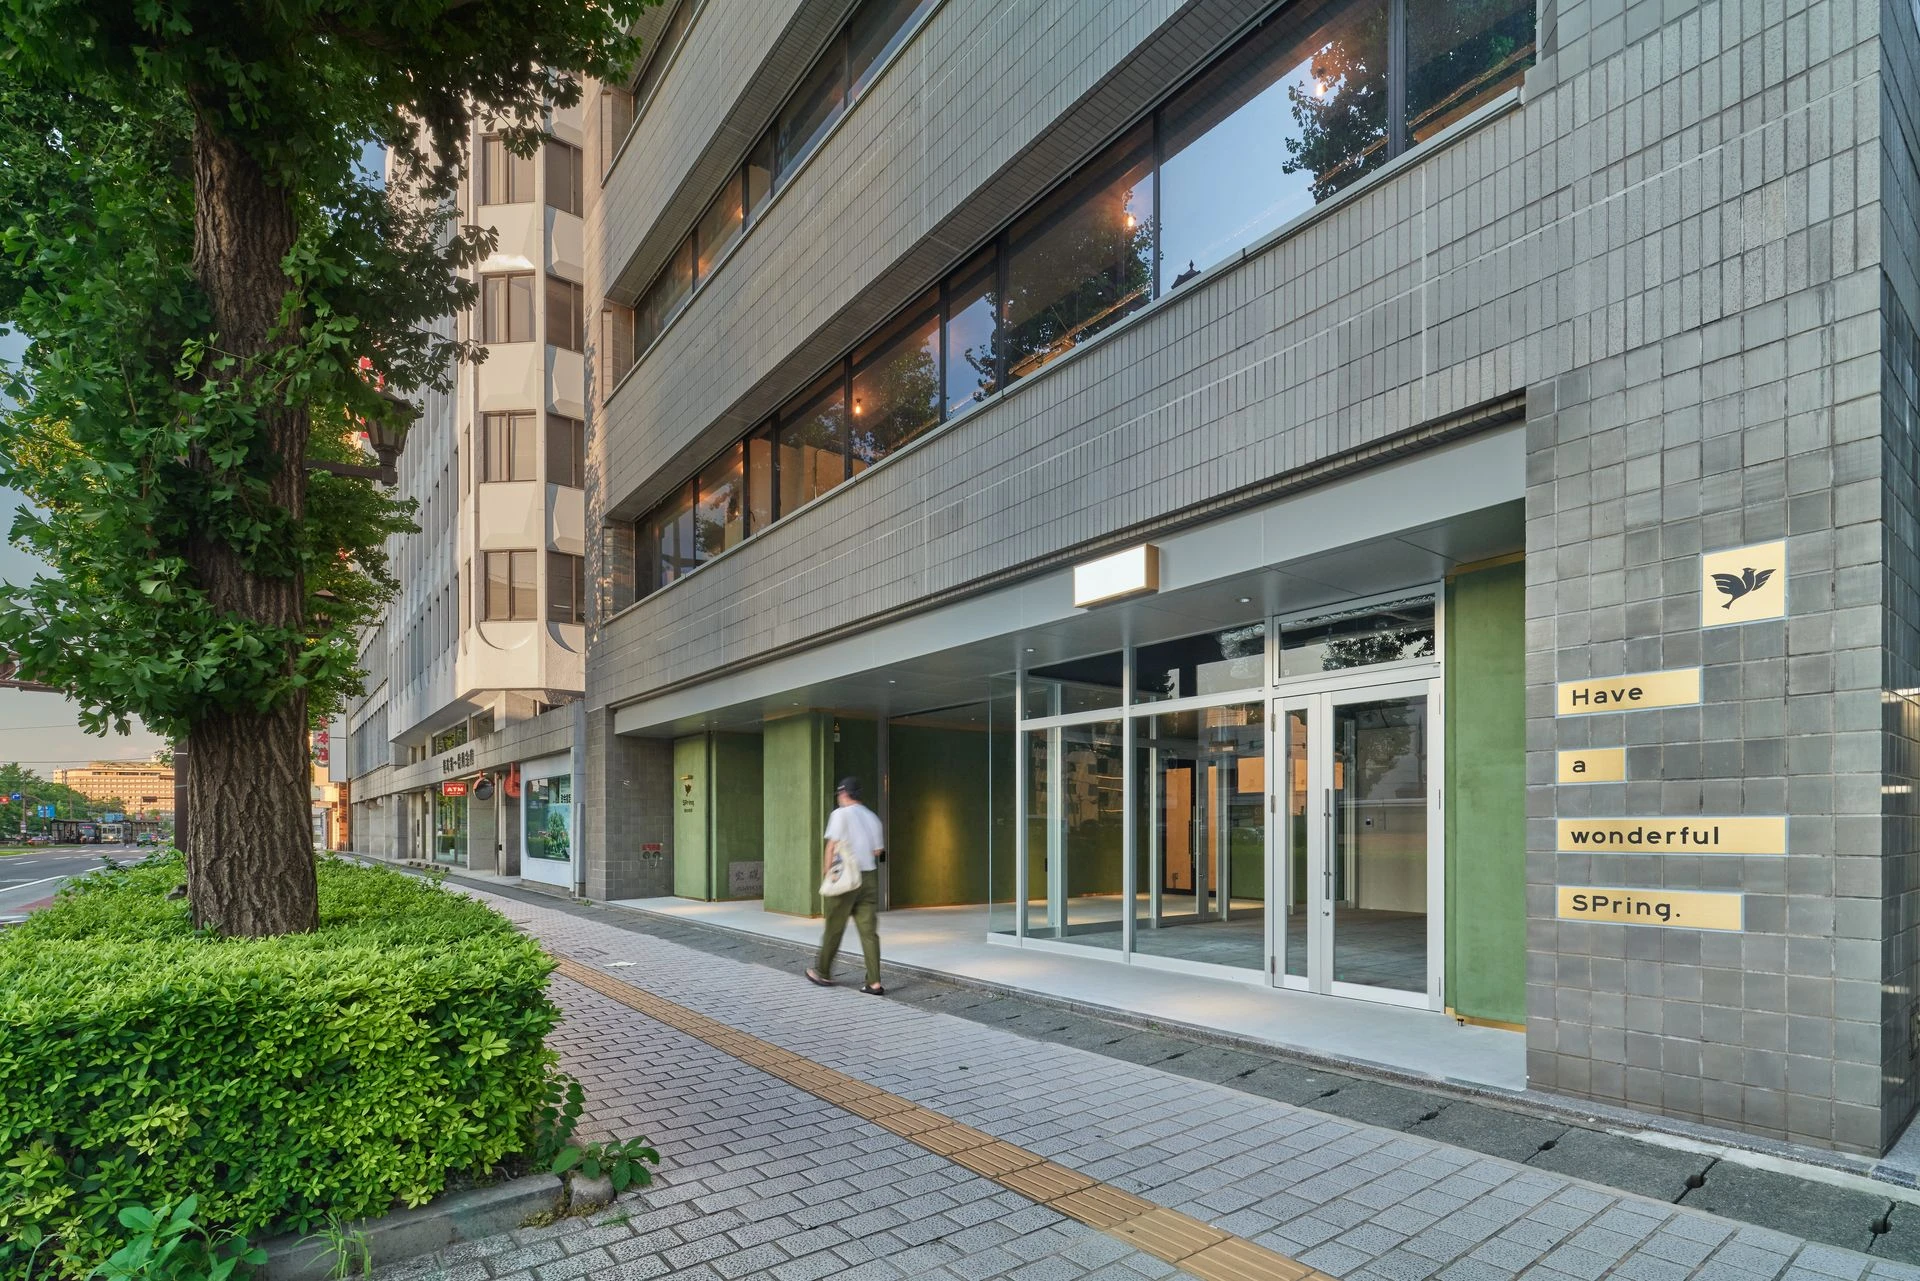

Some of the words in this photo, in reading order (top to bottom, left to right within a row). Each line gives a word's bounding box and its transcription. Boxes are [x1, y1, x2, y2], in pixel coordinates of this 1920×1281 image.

[1572, 687, 1643, 706] Have
[1572, 760, 1586, 773] a
[1571, 826, 1719, 845] wonderful
